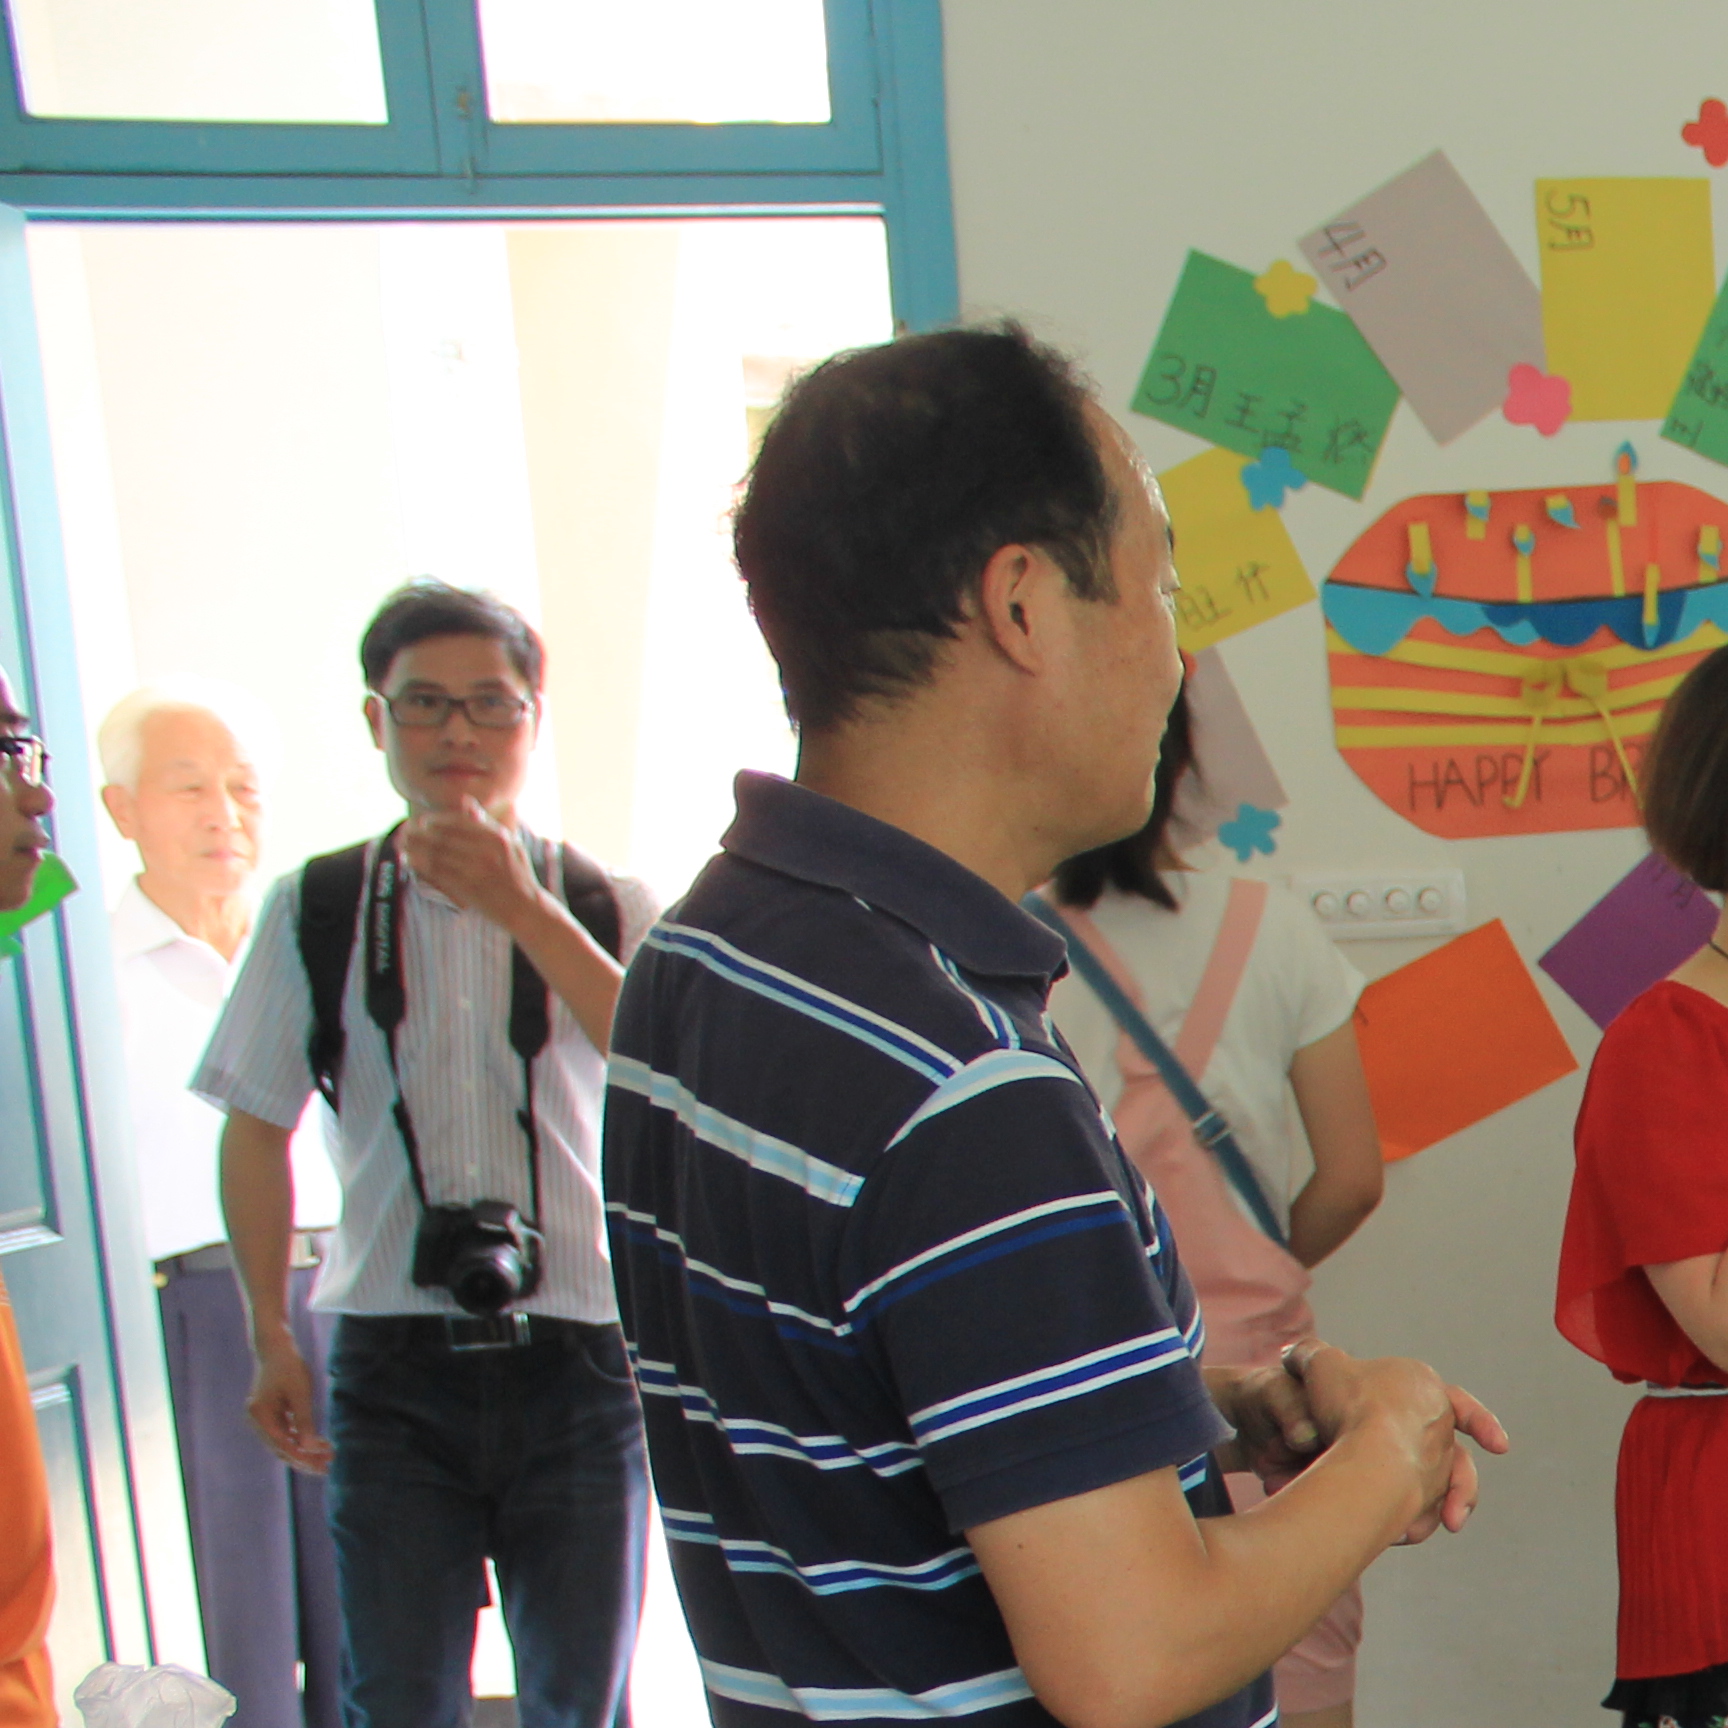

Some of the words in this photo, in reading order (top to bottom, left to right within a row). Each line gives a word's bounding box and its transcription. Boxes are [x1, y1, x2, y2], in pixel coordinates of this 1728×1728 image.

[1545, 188, 1595, 251] 5月
[1318, 219, 1388, 292] 4月
[1407, 752, 1551, 812] HAPPY
